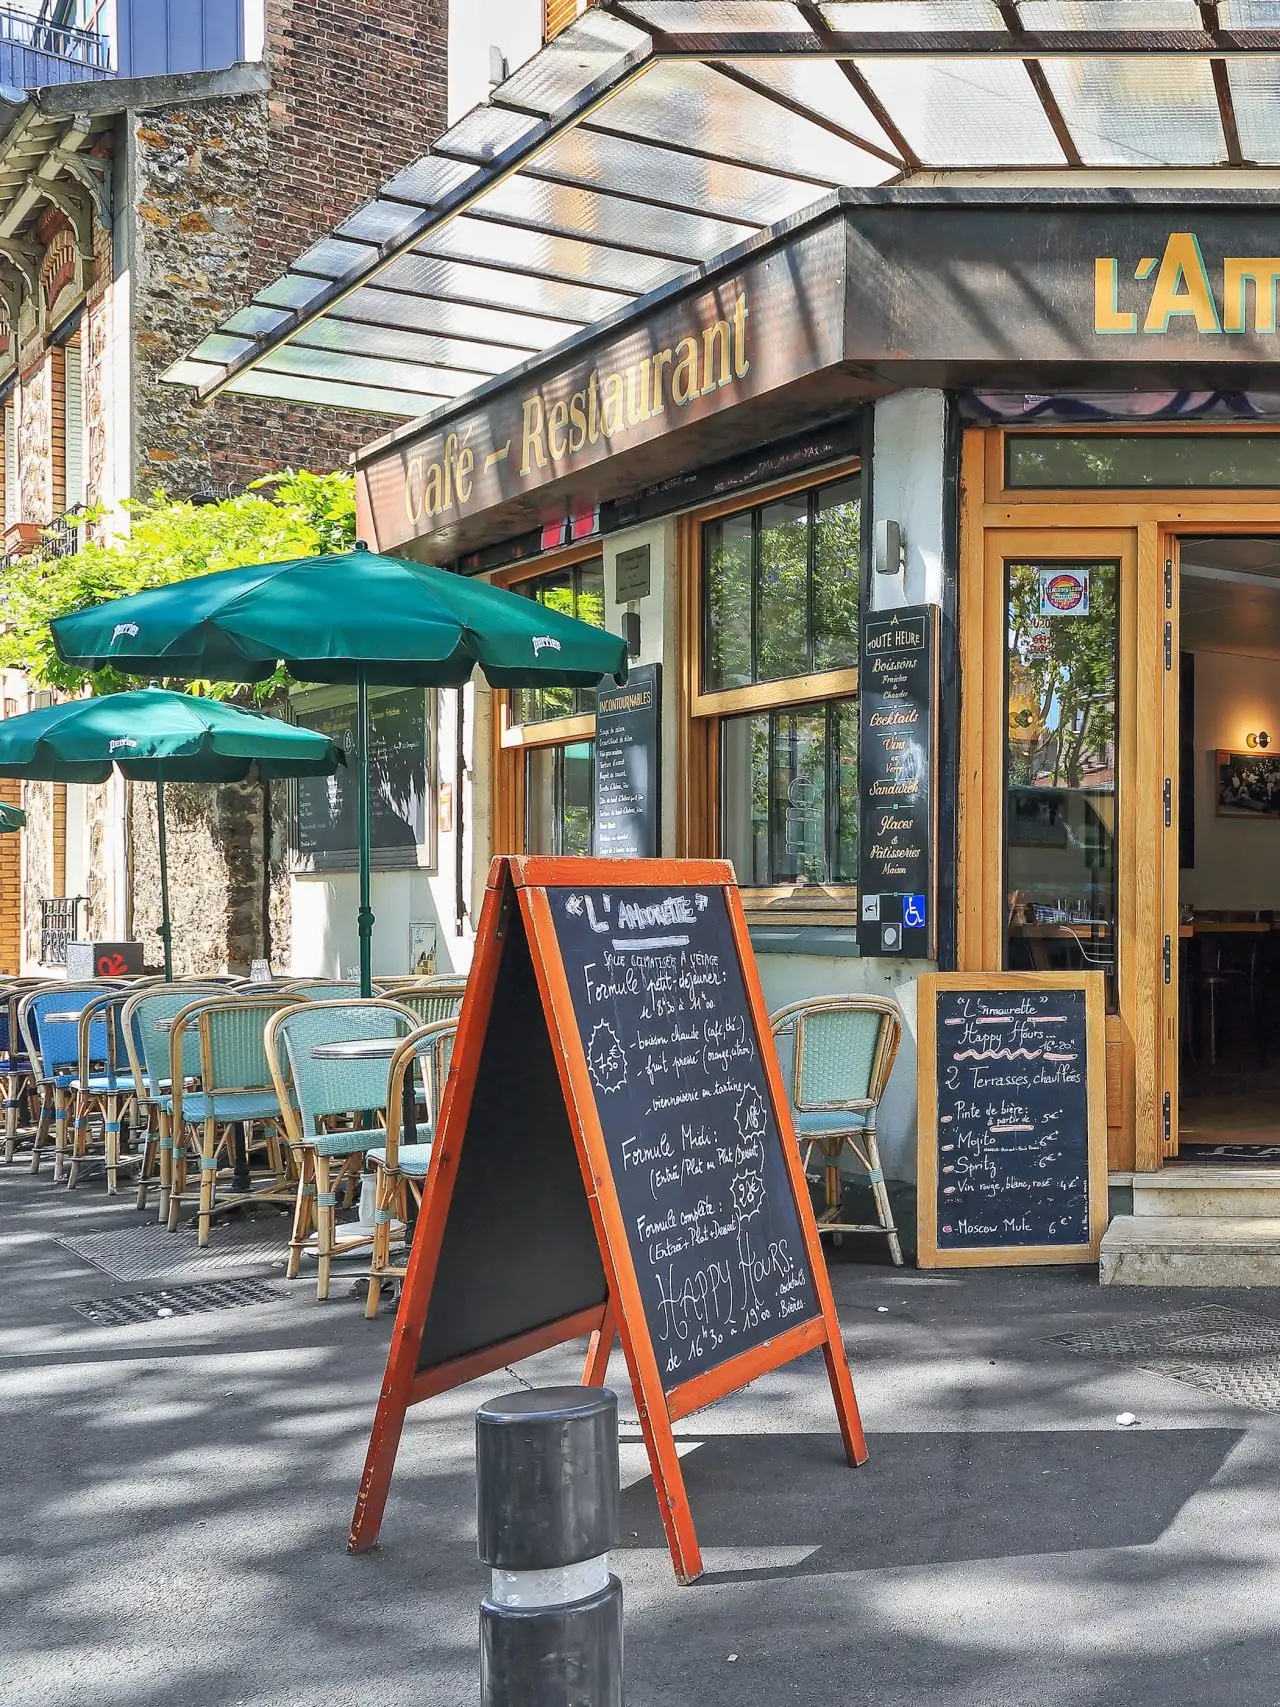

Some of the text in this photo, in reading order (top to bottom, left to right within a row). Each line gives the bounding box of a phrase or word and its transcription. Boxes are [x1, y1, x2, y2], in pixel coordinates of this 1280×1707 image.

[404, 425, 475, 525] Café
[519, 292, 751, 477] Restaurant
[867, 631, 921, 649] TOUTE HEURE
[599, 691, 651, 713] INCONTOURNABLES
[869, 709, 919, 727] Cocktails
[883, 736, 906, 751] Vins
[869, 782, 919, 796] Sandwich
[877, 815, 914, 836] Glaces
[869, 844, 921, 859] Pâtisseries
[881, 863, 907, 875] Maison
[584, 963, 640, 1004] Formule
[640, 1008, 653, 1019] de
[678, 1000, 684, 1011] à
[637, 1030, 668, 1050] boisson
[671, 1024, 699, 1042] chaude
[958, 1021, 1002, 1052] Happy
[645, 1051, 669, 1085] fruit
[672, 1050, 700, 1078] pressé
[945, 1066, 960, 1090] 2
[1033, 1063, 1081, 1084] chauffées
[652, 1076, 744, 1111] viennoiserie ou tartine
[954, 1100, 981, 1120] Pinte
[986, 1103, 998, 1115] de
[994, 1115, 1019, 1127] partir
[1021, 1115, 1030, 1123] de
[621, 1132, 675, 1171] Formule
[957, 1130, 996, 1157] Mojito
[706, 1161, 715, 1170] ou
[954, 1156, 997, 1178] Spritz
[958, 1178, 974, 1192] Vin
[1033, 1177, 1052, 1188] rosé
[637, 1209, 677, 1242] Formule
[958, 1219, 998, 1235] Moscow
[1004, 1218, 1032, 1231] Mule
[780, 1268, 806, 1296] cocktails
[654, 1259, 736, 1340] HAPPY
[666, 1347, 682, 1373] de
[730, 1327, 737, 1336] à
